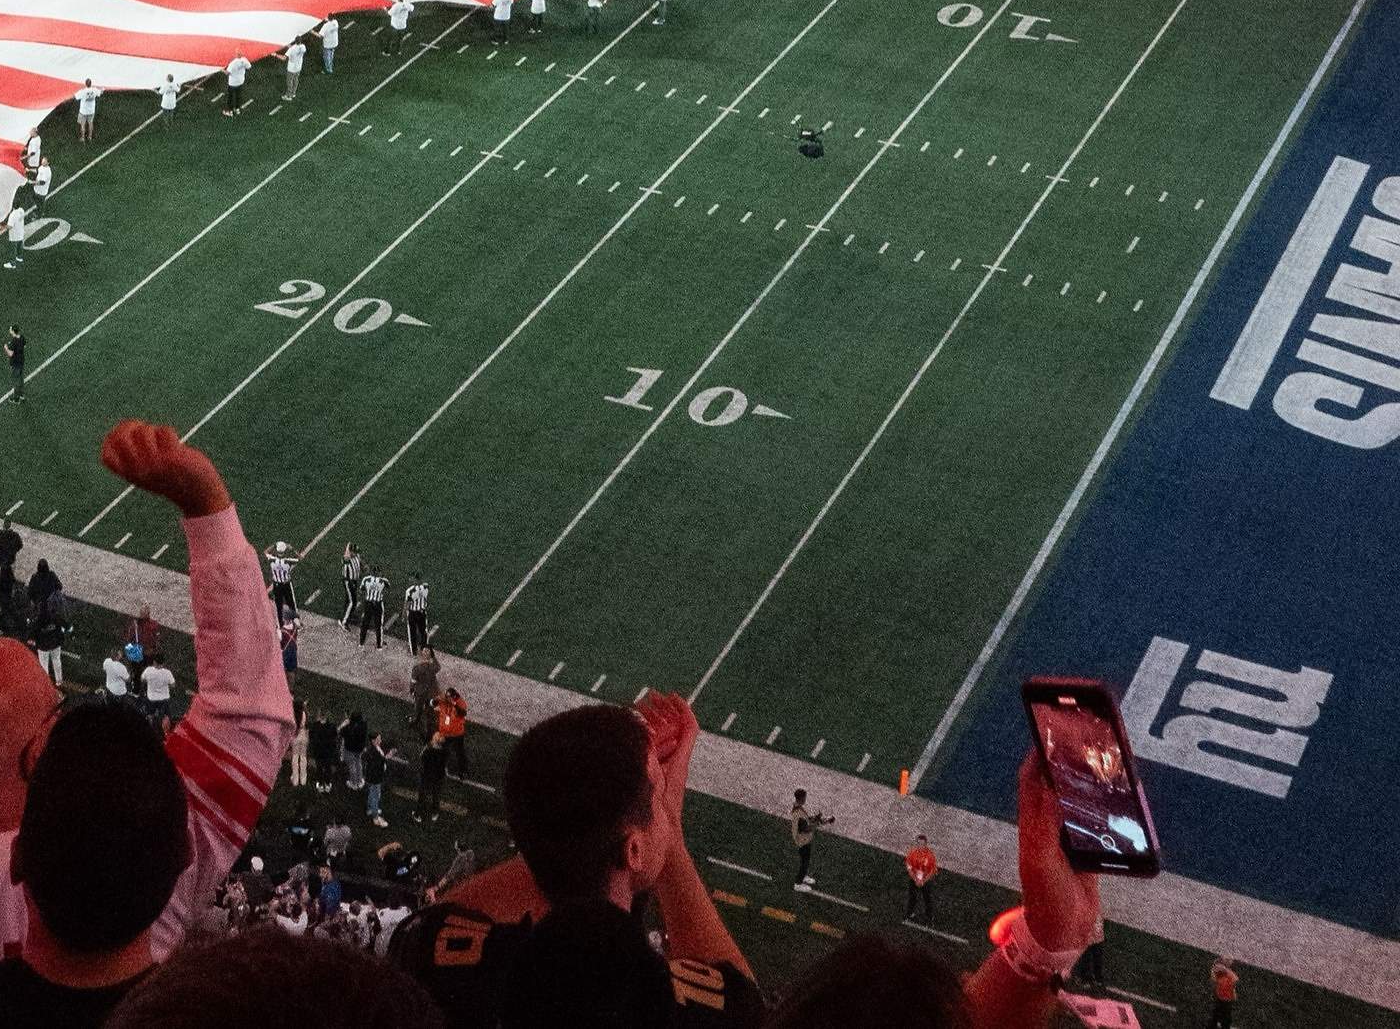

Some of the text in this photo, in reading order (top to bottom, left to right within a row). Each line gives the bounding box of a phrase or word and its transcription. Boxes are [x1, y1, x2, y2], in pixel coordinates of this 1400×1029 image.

[255, 279, 396, 335] 20
[603, 367, 750, 428] 10
[668, 958, 725, 1010] 10
